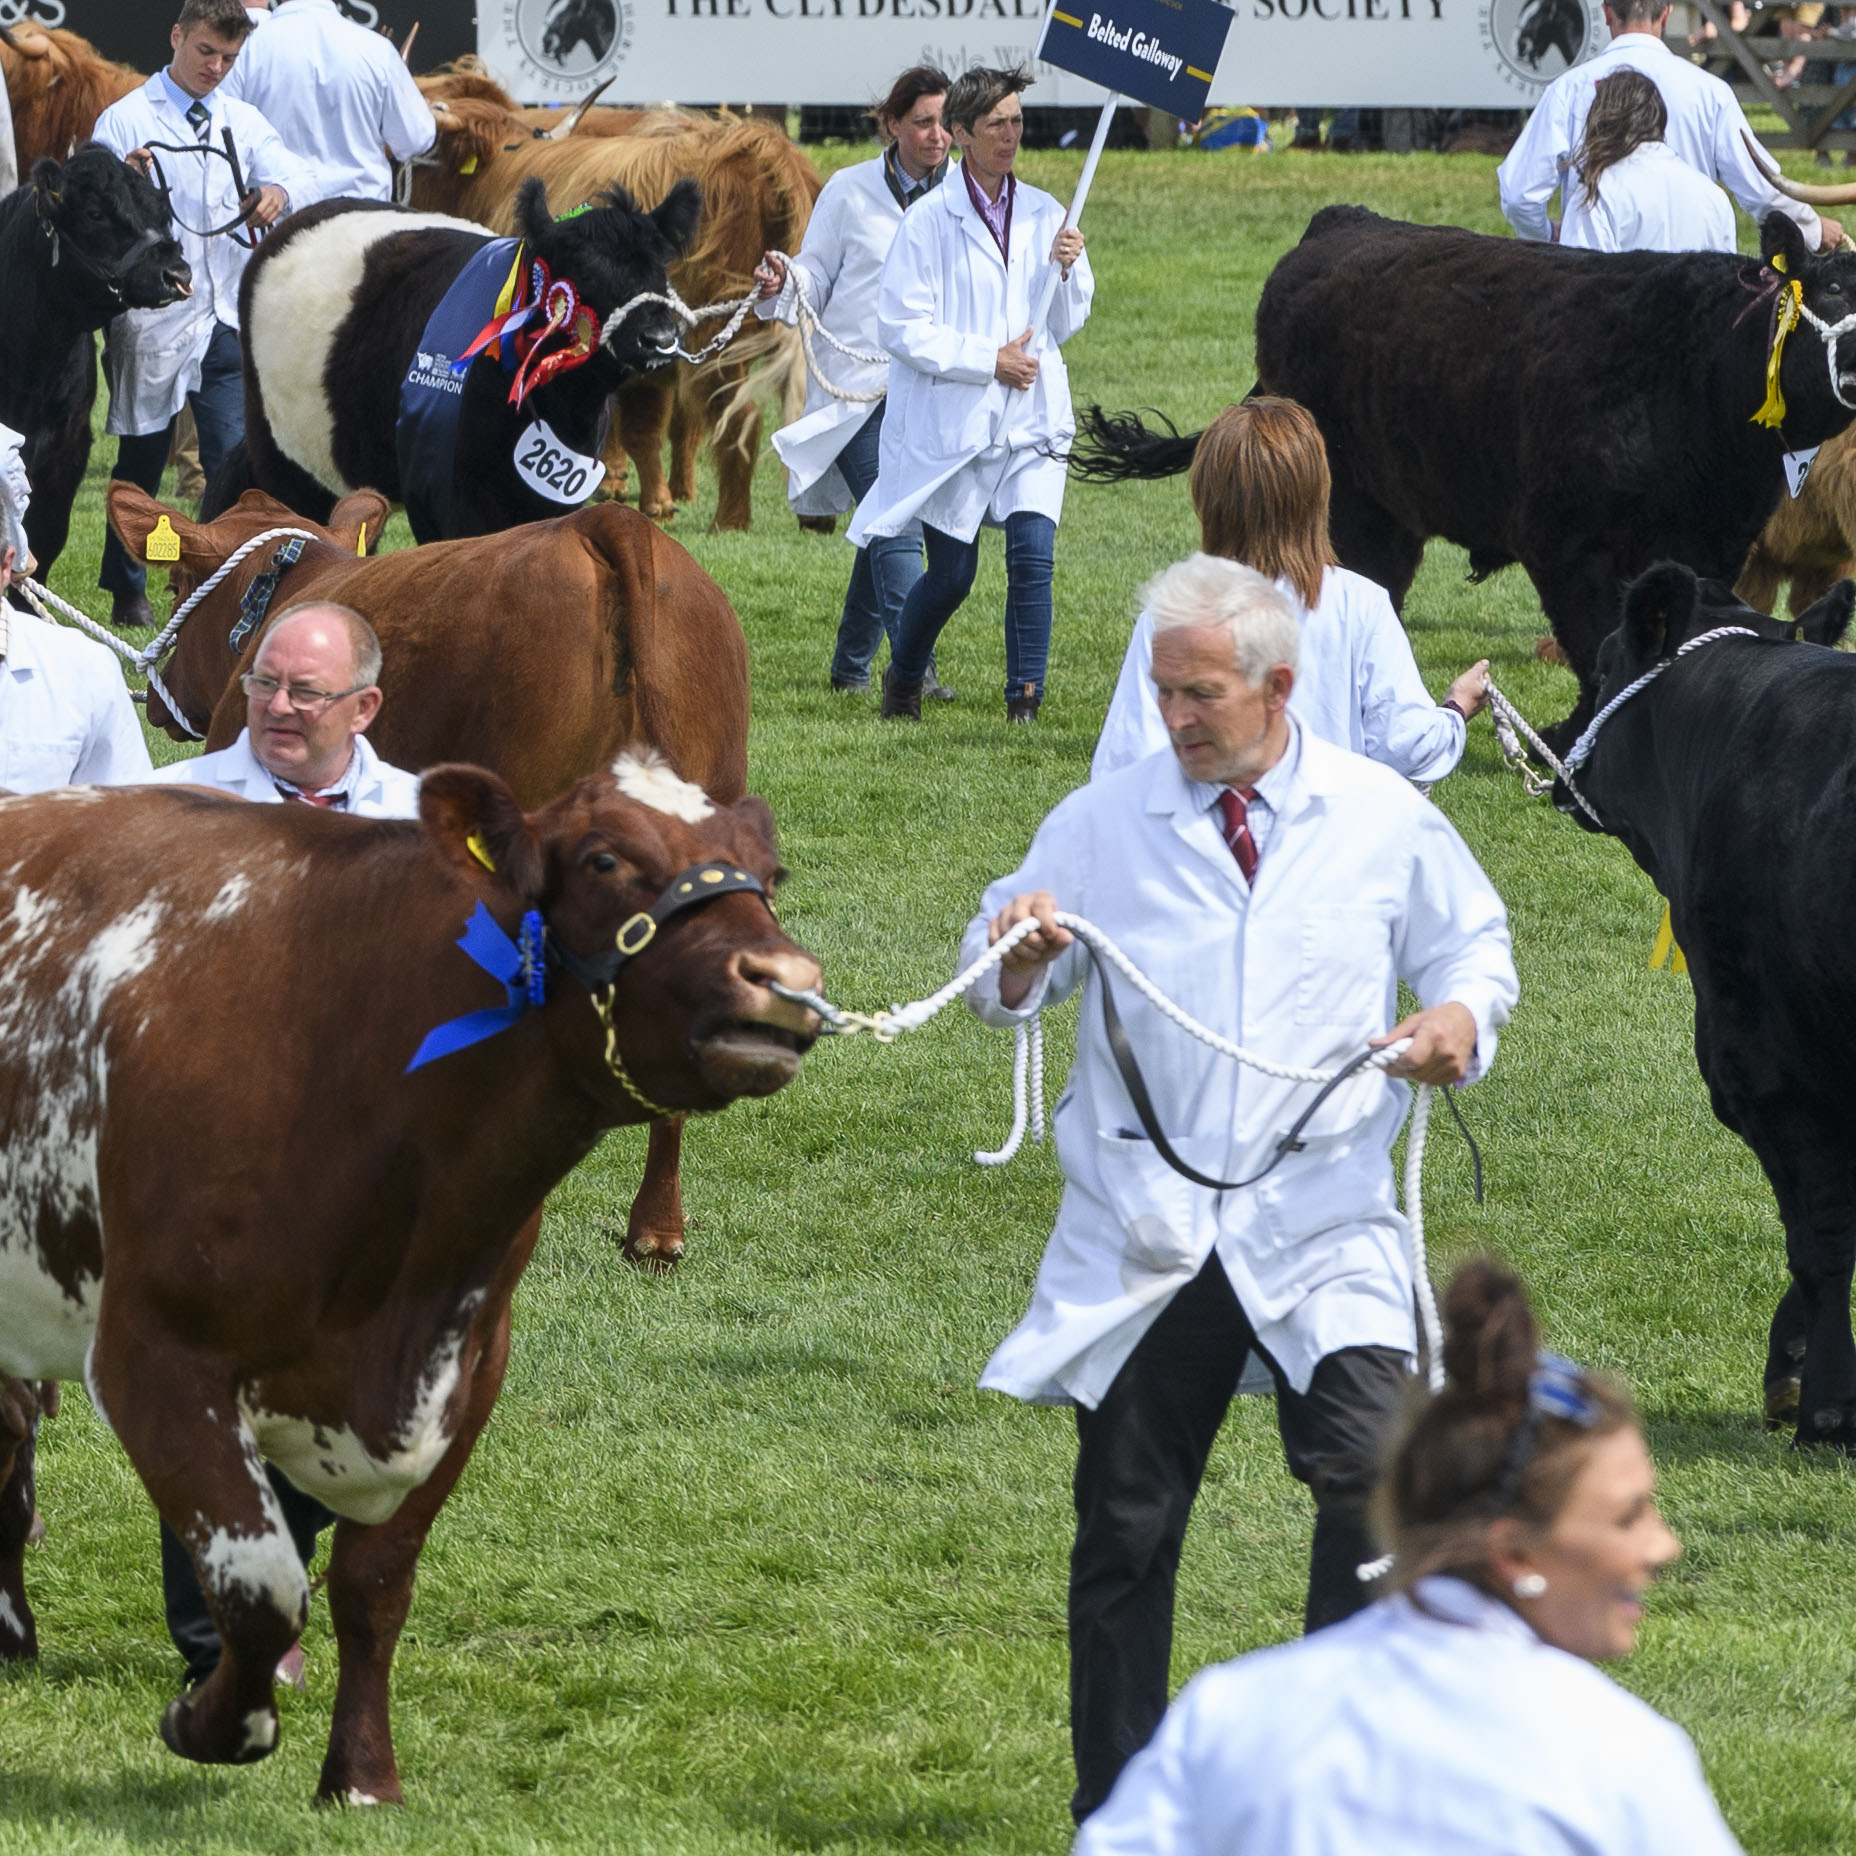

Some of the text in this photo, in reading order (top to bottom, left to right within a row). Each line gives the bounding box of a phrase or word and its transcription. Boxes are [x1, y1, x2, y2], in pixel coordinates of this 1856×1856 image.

[502, 3, 518, 49] THE
[1087, 12, 1184, 83] Belted Galloway
[408, 369, 464, 396] CHAMPION
[518, 437, 588, 498] 2620
